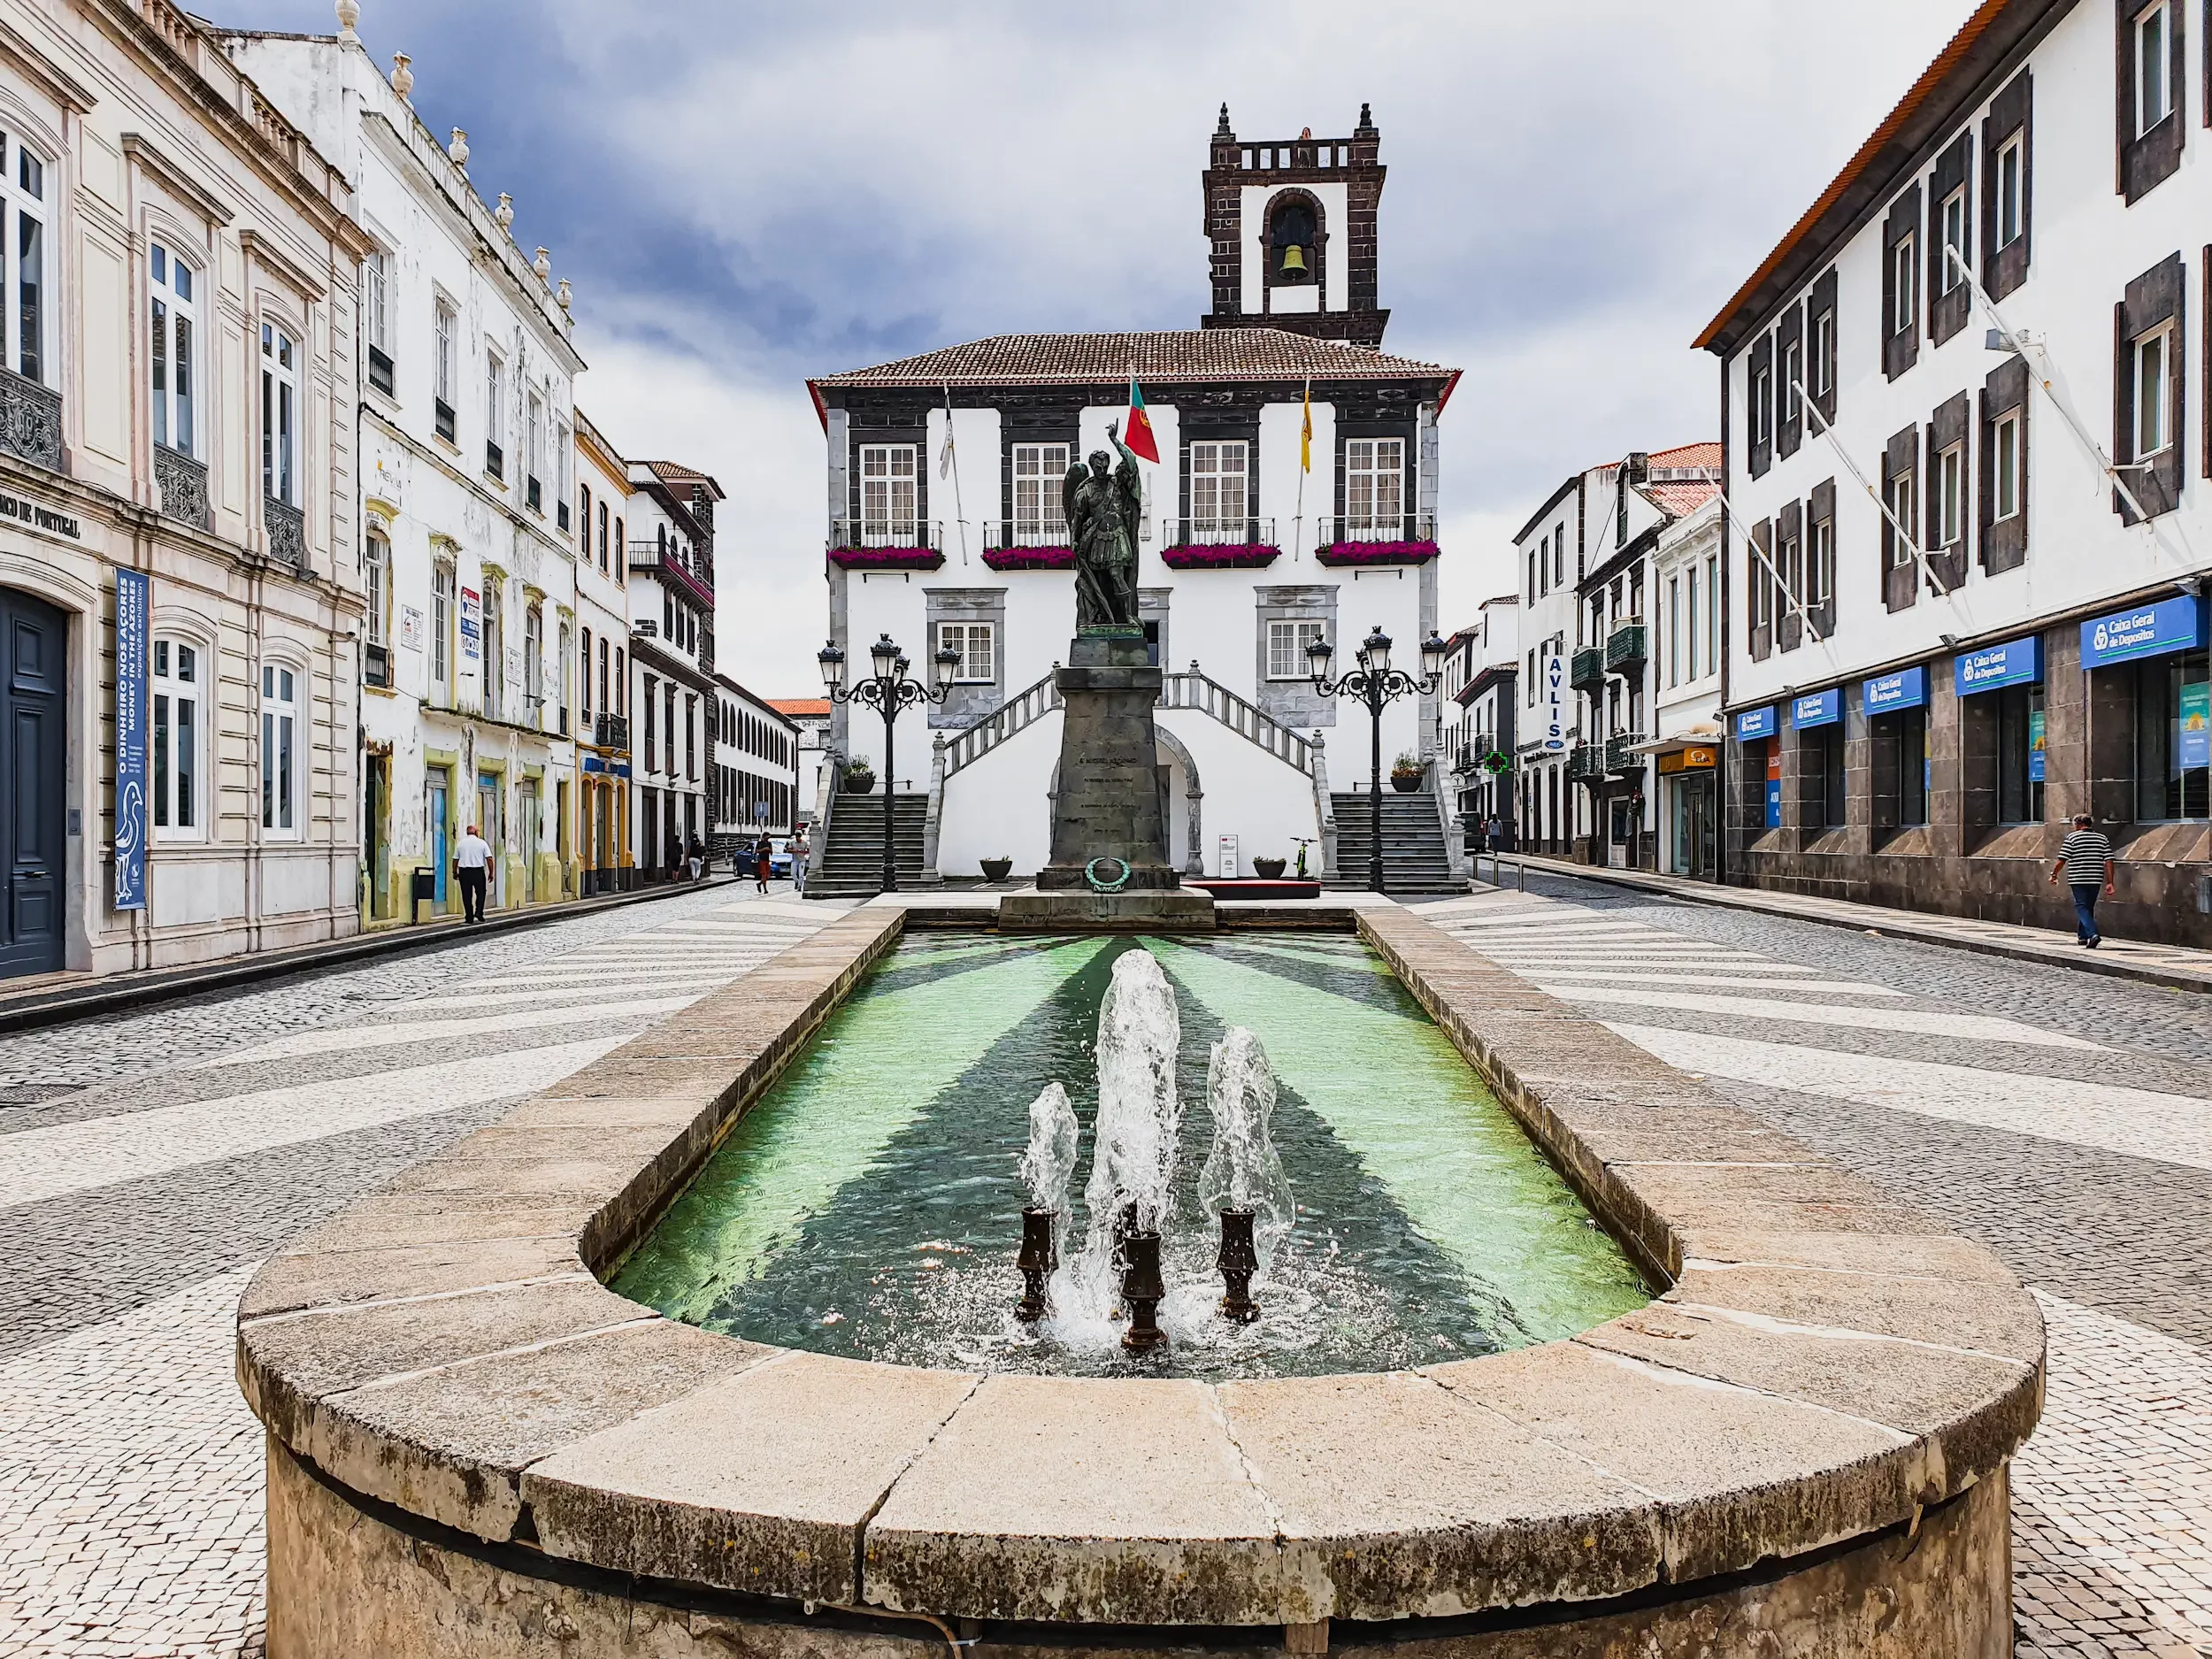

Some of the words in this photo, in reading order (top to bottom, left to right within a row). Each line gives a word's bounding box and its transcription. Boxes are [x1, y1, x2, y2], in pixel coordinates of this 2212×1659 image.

[19, 501, 32, 523] DE
[35, 506, 81, 540] PORTUGAL
[119, 577, 128, 639] AÇORES
[2109, 619, 2131, 634] Caixa
[2132, 611, 2154, 628] Geral
[2109, 636, 2118, 648] de
[2118, 629, 2154, 647] Depositos
[1974, 656, 1989, 668] Caixa
[1989, 649, 2006, 664] Geral
[128, 663, 135, 678] IN
[1974, 670, 1981, 680] de
[1548, 658, 1562, 737] AVLIS
[119, 761, 127, 774] O
